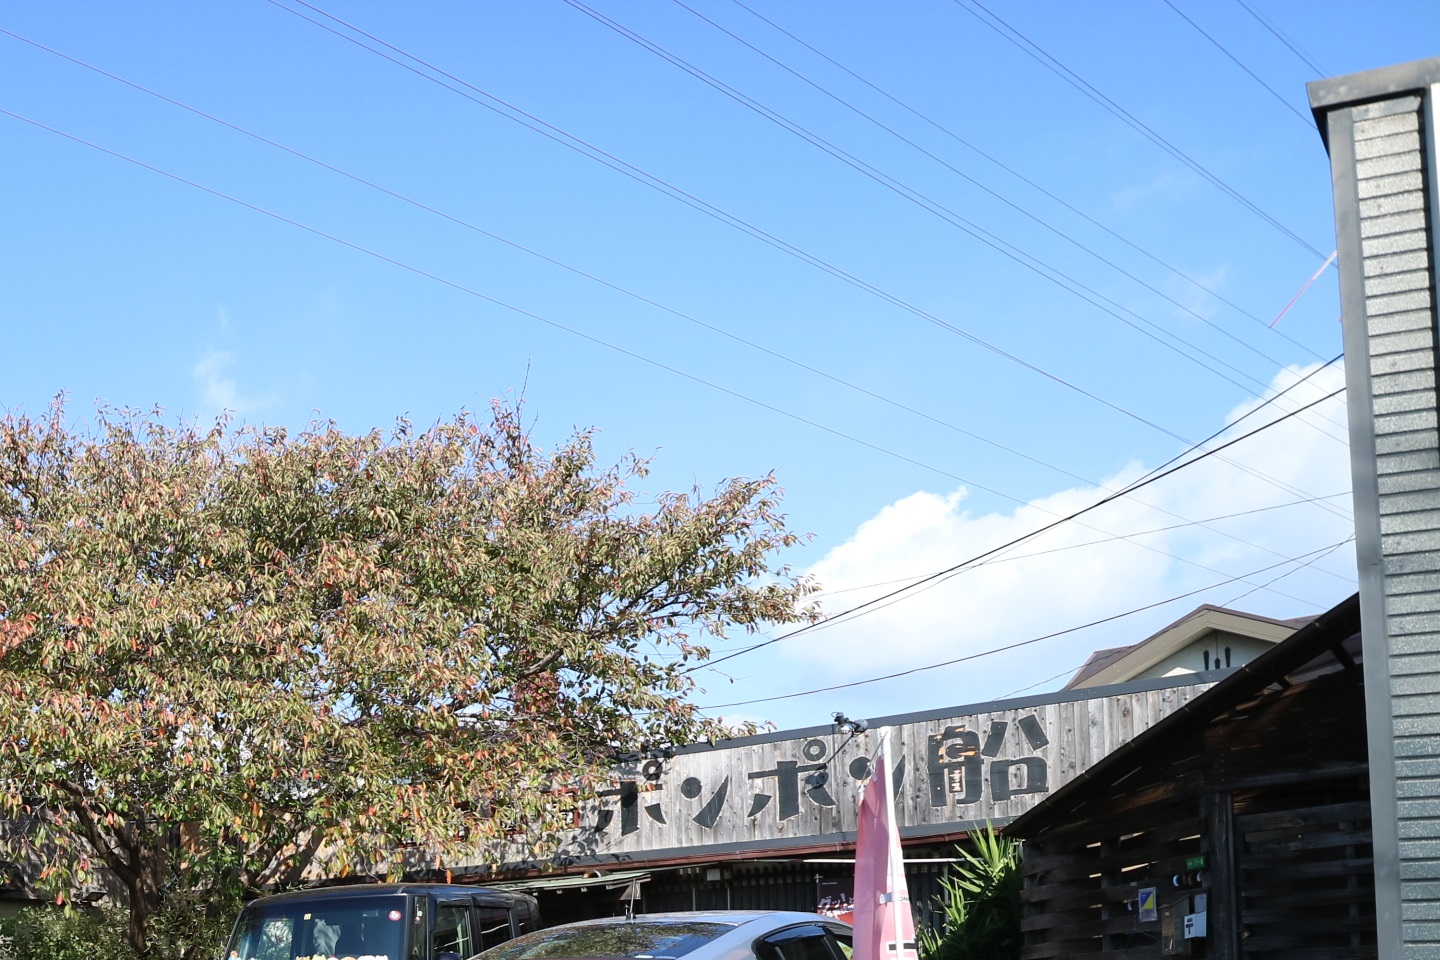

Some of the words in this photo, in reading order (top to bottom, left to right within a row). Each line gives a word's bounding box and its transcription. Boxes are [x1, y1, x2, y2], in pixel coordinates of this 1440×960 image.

[591, 713, 1050, 838] ポンポン船
